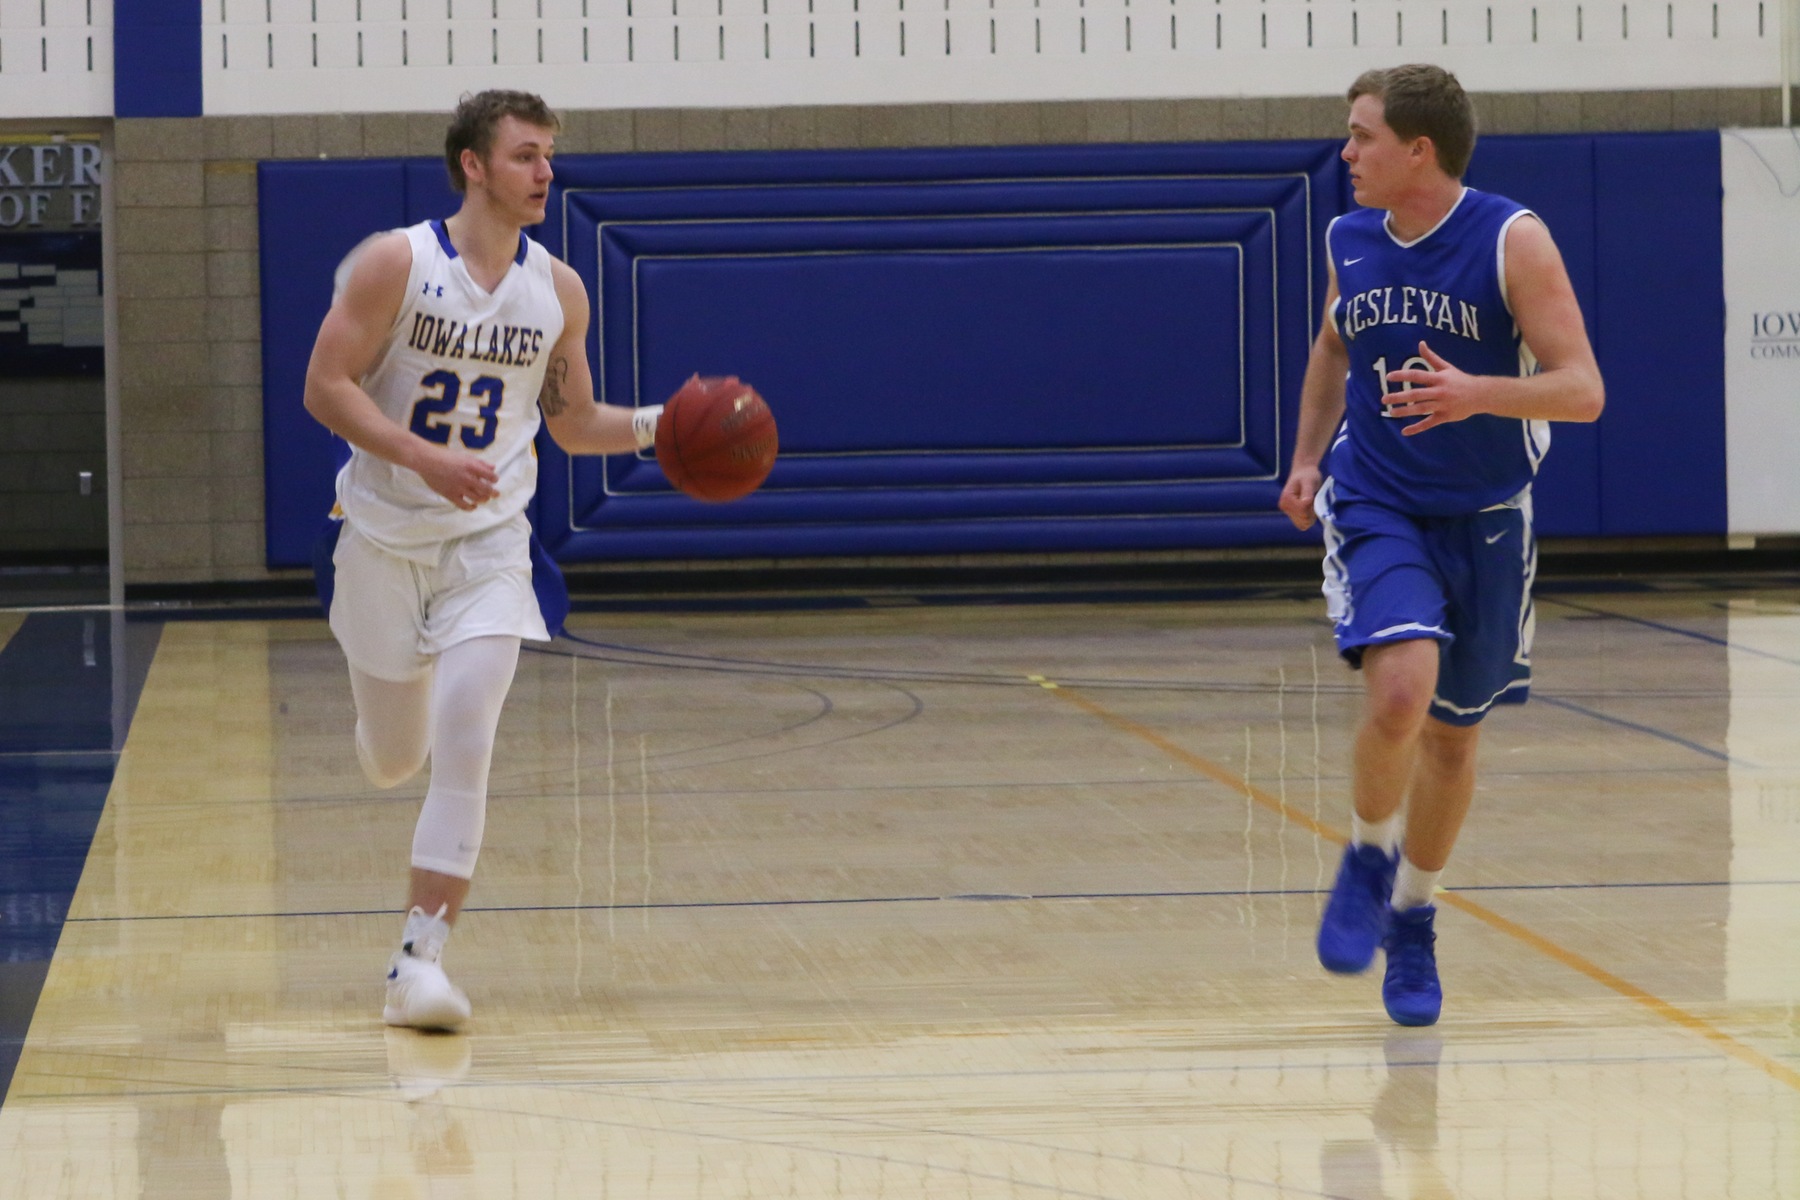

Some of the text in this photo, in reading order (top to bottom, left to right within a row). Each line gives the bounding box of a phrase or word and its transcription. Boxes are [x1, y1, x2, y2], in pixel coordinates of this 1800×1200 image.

[0, 191, 101, 226] OF F
[408, 311, 543, 367] IOWA LAKES
[409, 368, 504, 450] 23
